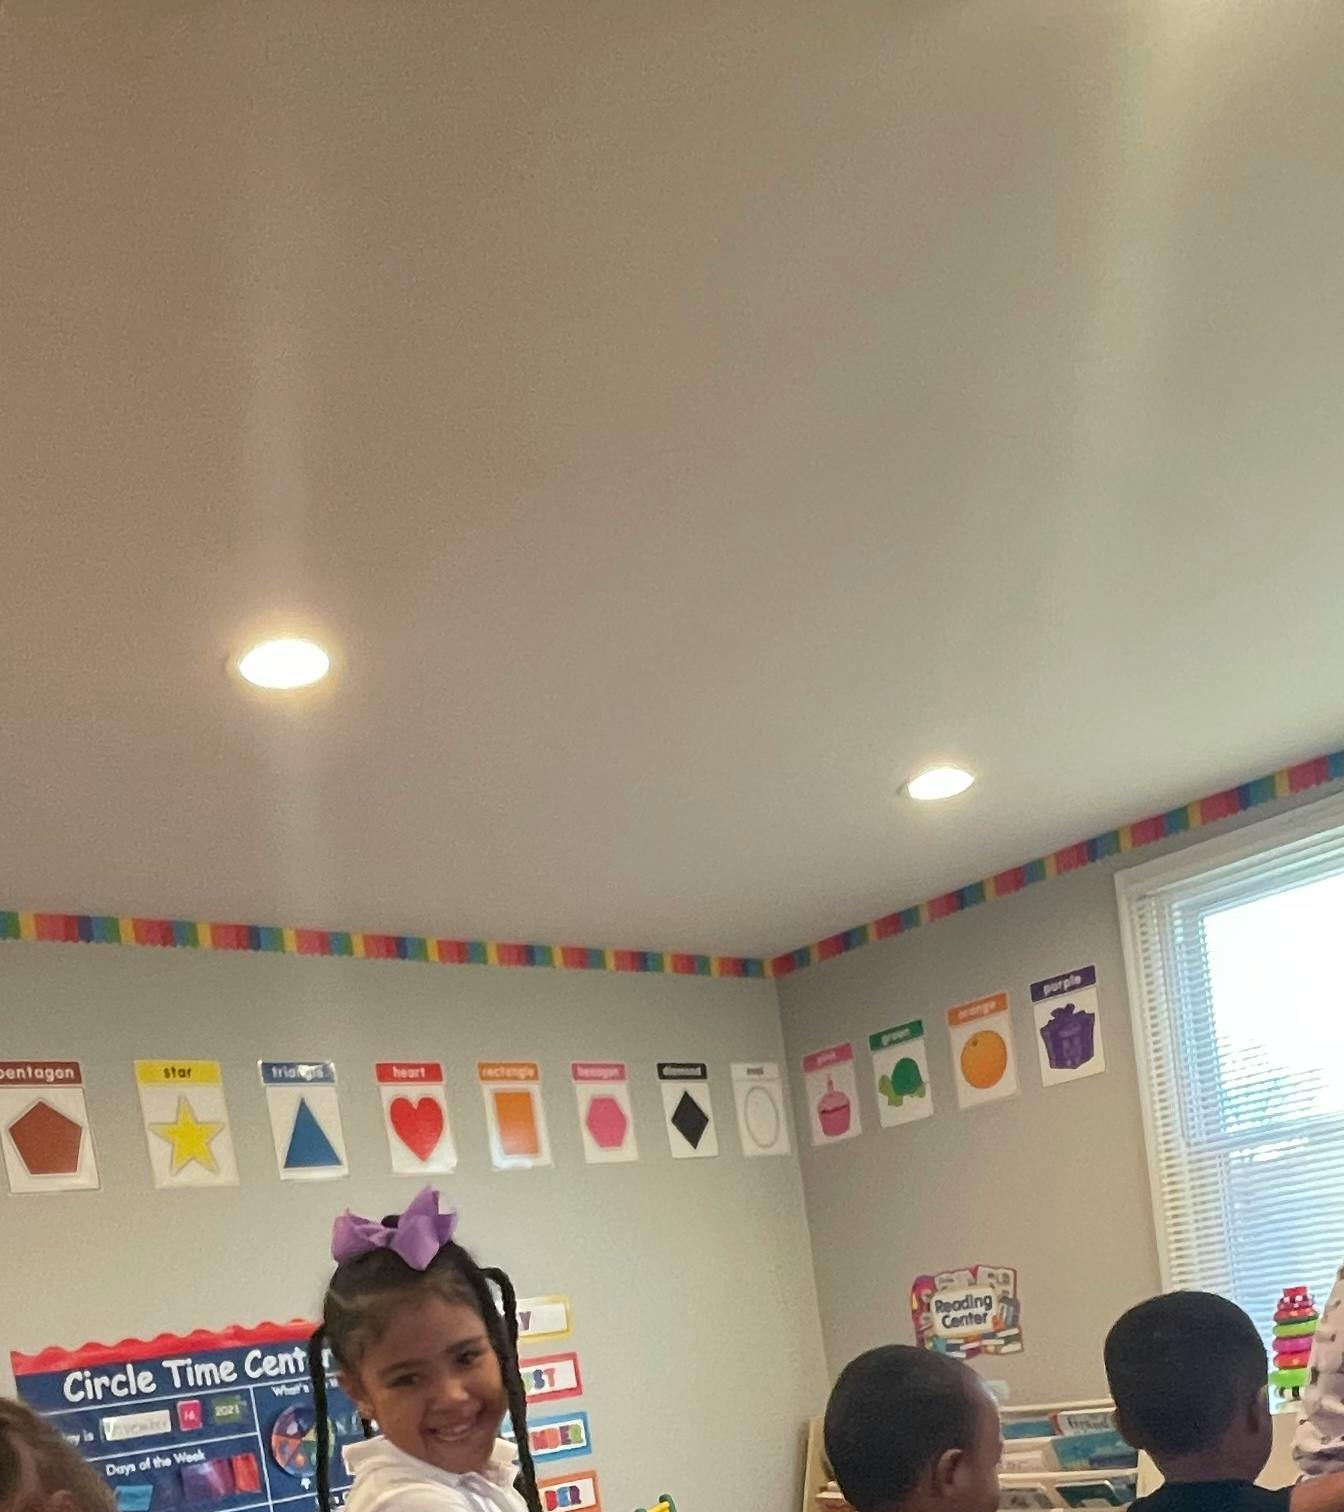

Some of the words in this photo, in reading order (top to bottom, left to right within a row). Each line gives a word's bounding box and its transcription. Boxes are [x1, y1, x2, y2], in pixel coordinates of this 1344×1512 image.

[163, 1066, 192, 1079] star
[392, 1065, 425, 1078] heart
[934, 1294, 993, 1313] Reading
[941, 1312, 989, 1329] Center
[63, 1363, 156, 1403] Circle
[161, 1358, 237, 1390] Time
[245, 1346, 334, 1379] Centr
[106, 1462, 135, 1478] Days
[139, 1457, 151, 1471] of
[153, 1454, 172, 1469] the
[173, 1450, 207, 1464] Week
